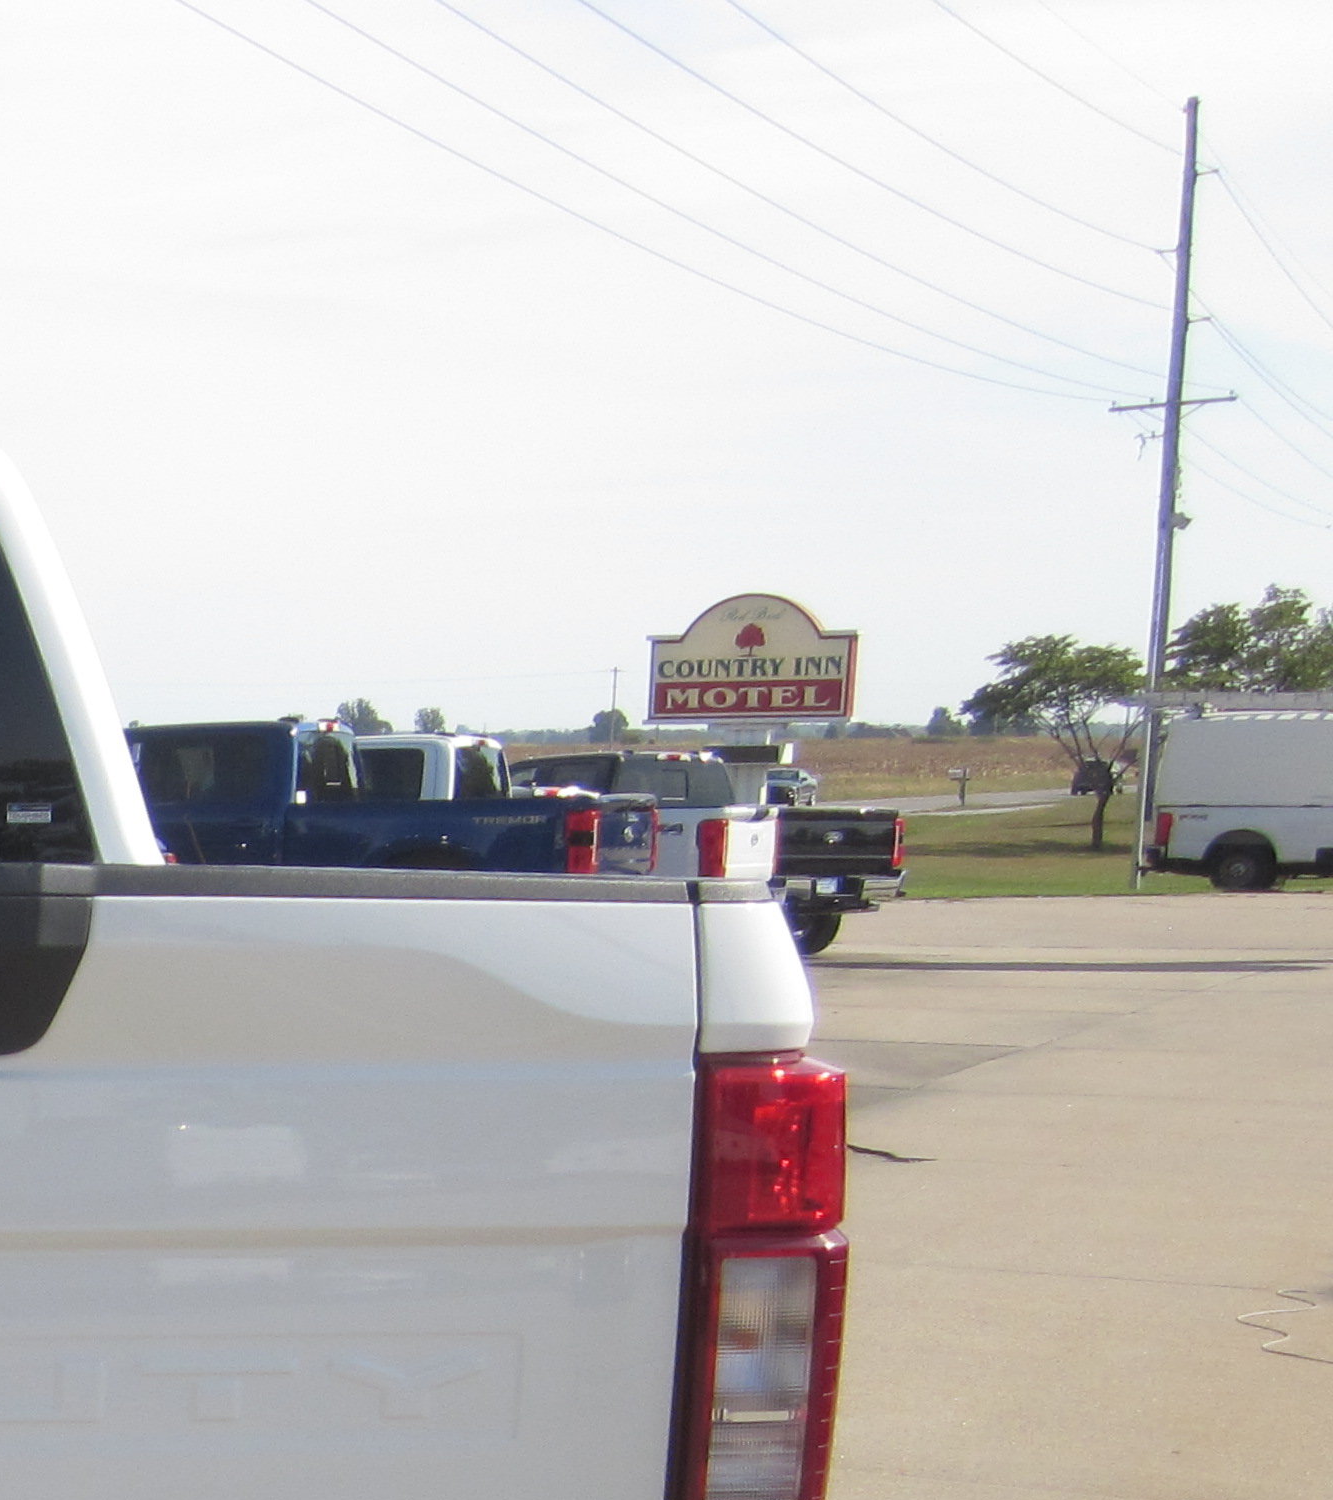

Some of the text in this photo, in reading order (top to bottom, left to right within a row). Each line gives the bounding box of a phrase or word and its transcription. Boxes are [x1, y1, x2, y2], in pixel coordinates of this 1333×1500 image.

[657, 655, 843, 679] COUNTRY INN
[665, 685, 831, 709] MOTEL
